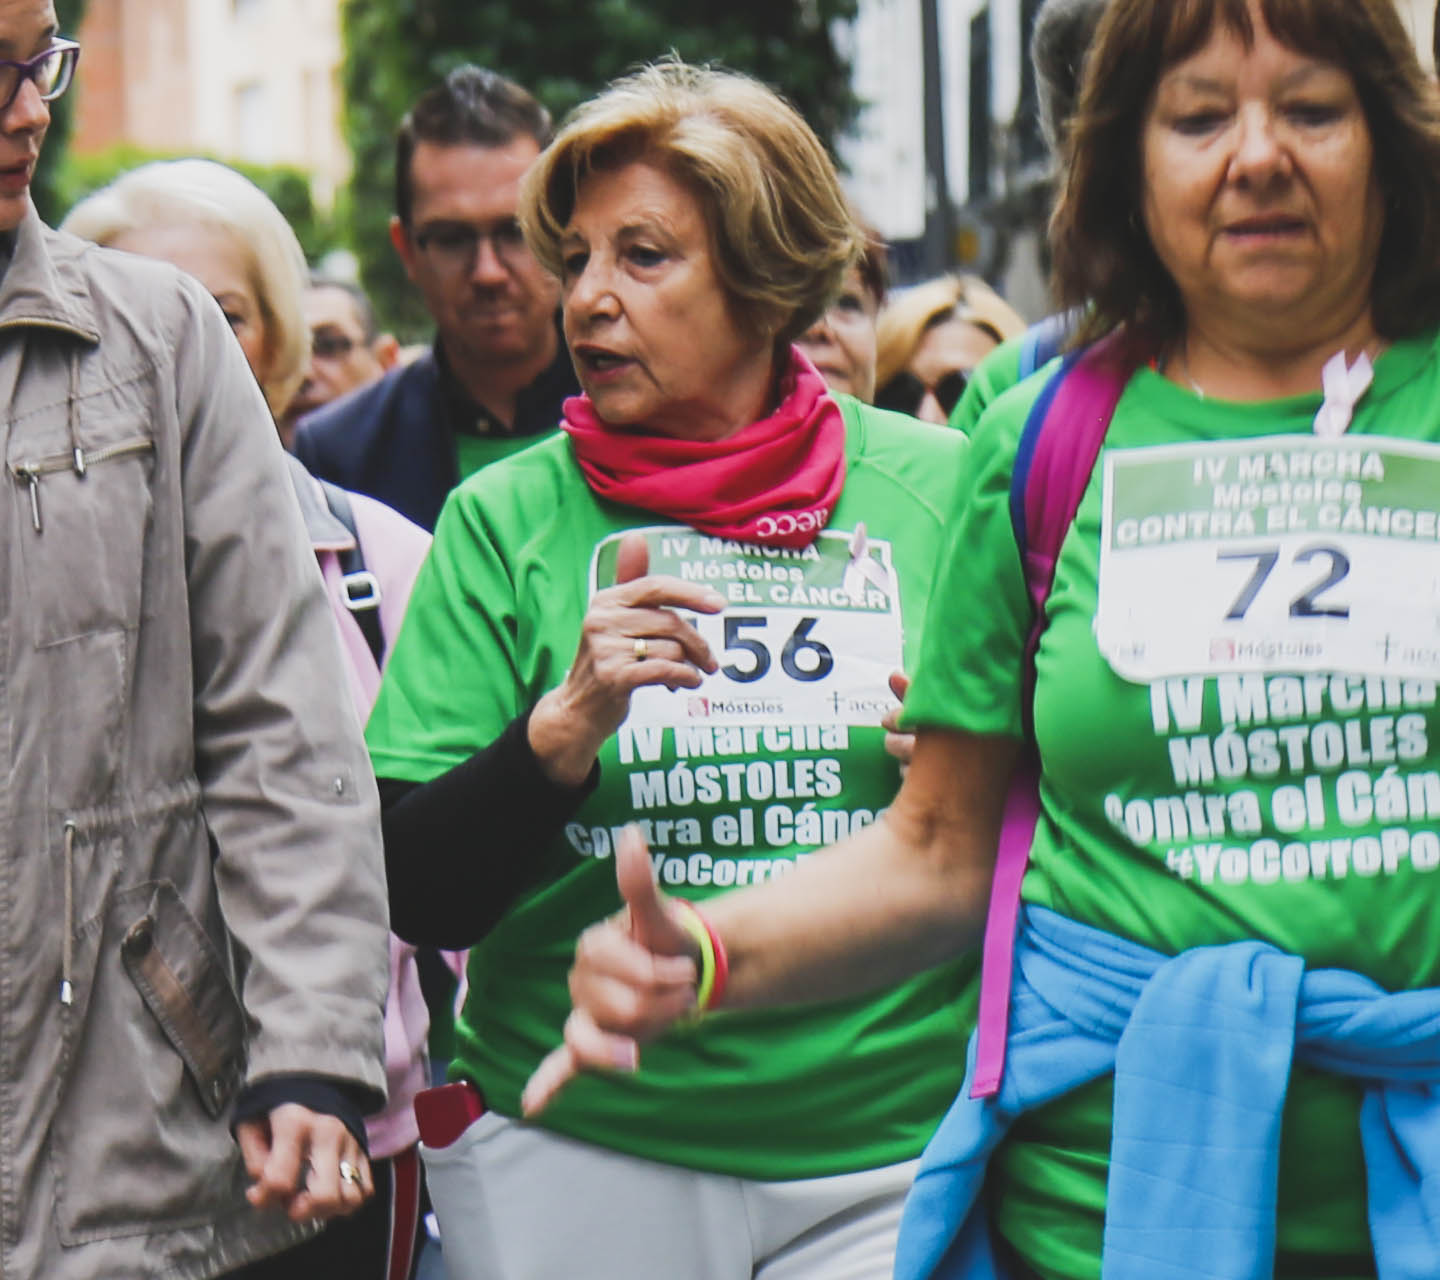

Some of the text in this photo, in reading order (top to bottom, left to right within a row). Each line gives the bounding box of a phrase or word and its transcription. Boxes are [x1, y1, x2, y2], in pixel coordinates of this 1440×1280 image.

[1192, 451, 1385, 484] IV MARCHA
[1117, 510, 1255, 545] CONTRA
[1267, 506, 1308, 531] EL
[662, 537, 688, 558] IV
[680, 560, 803, 582] Móstoles
[1216, 543, 1351, 621] 72
[728, 583, 763, 602] EL
[687, 616, 834, 683] 56
[1150, 674, 1204, 736] IV
[618, 727, 663, 764] IV
[1168, 713, 1429, 787] MÓSTOLES
[630, 758, 842, 810] MÓSTOLES
[1272, 775, 1325, 834] el
[712, 808, 754, 846] el
